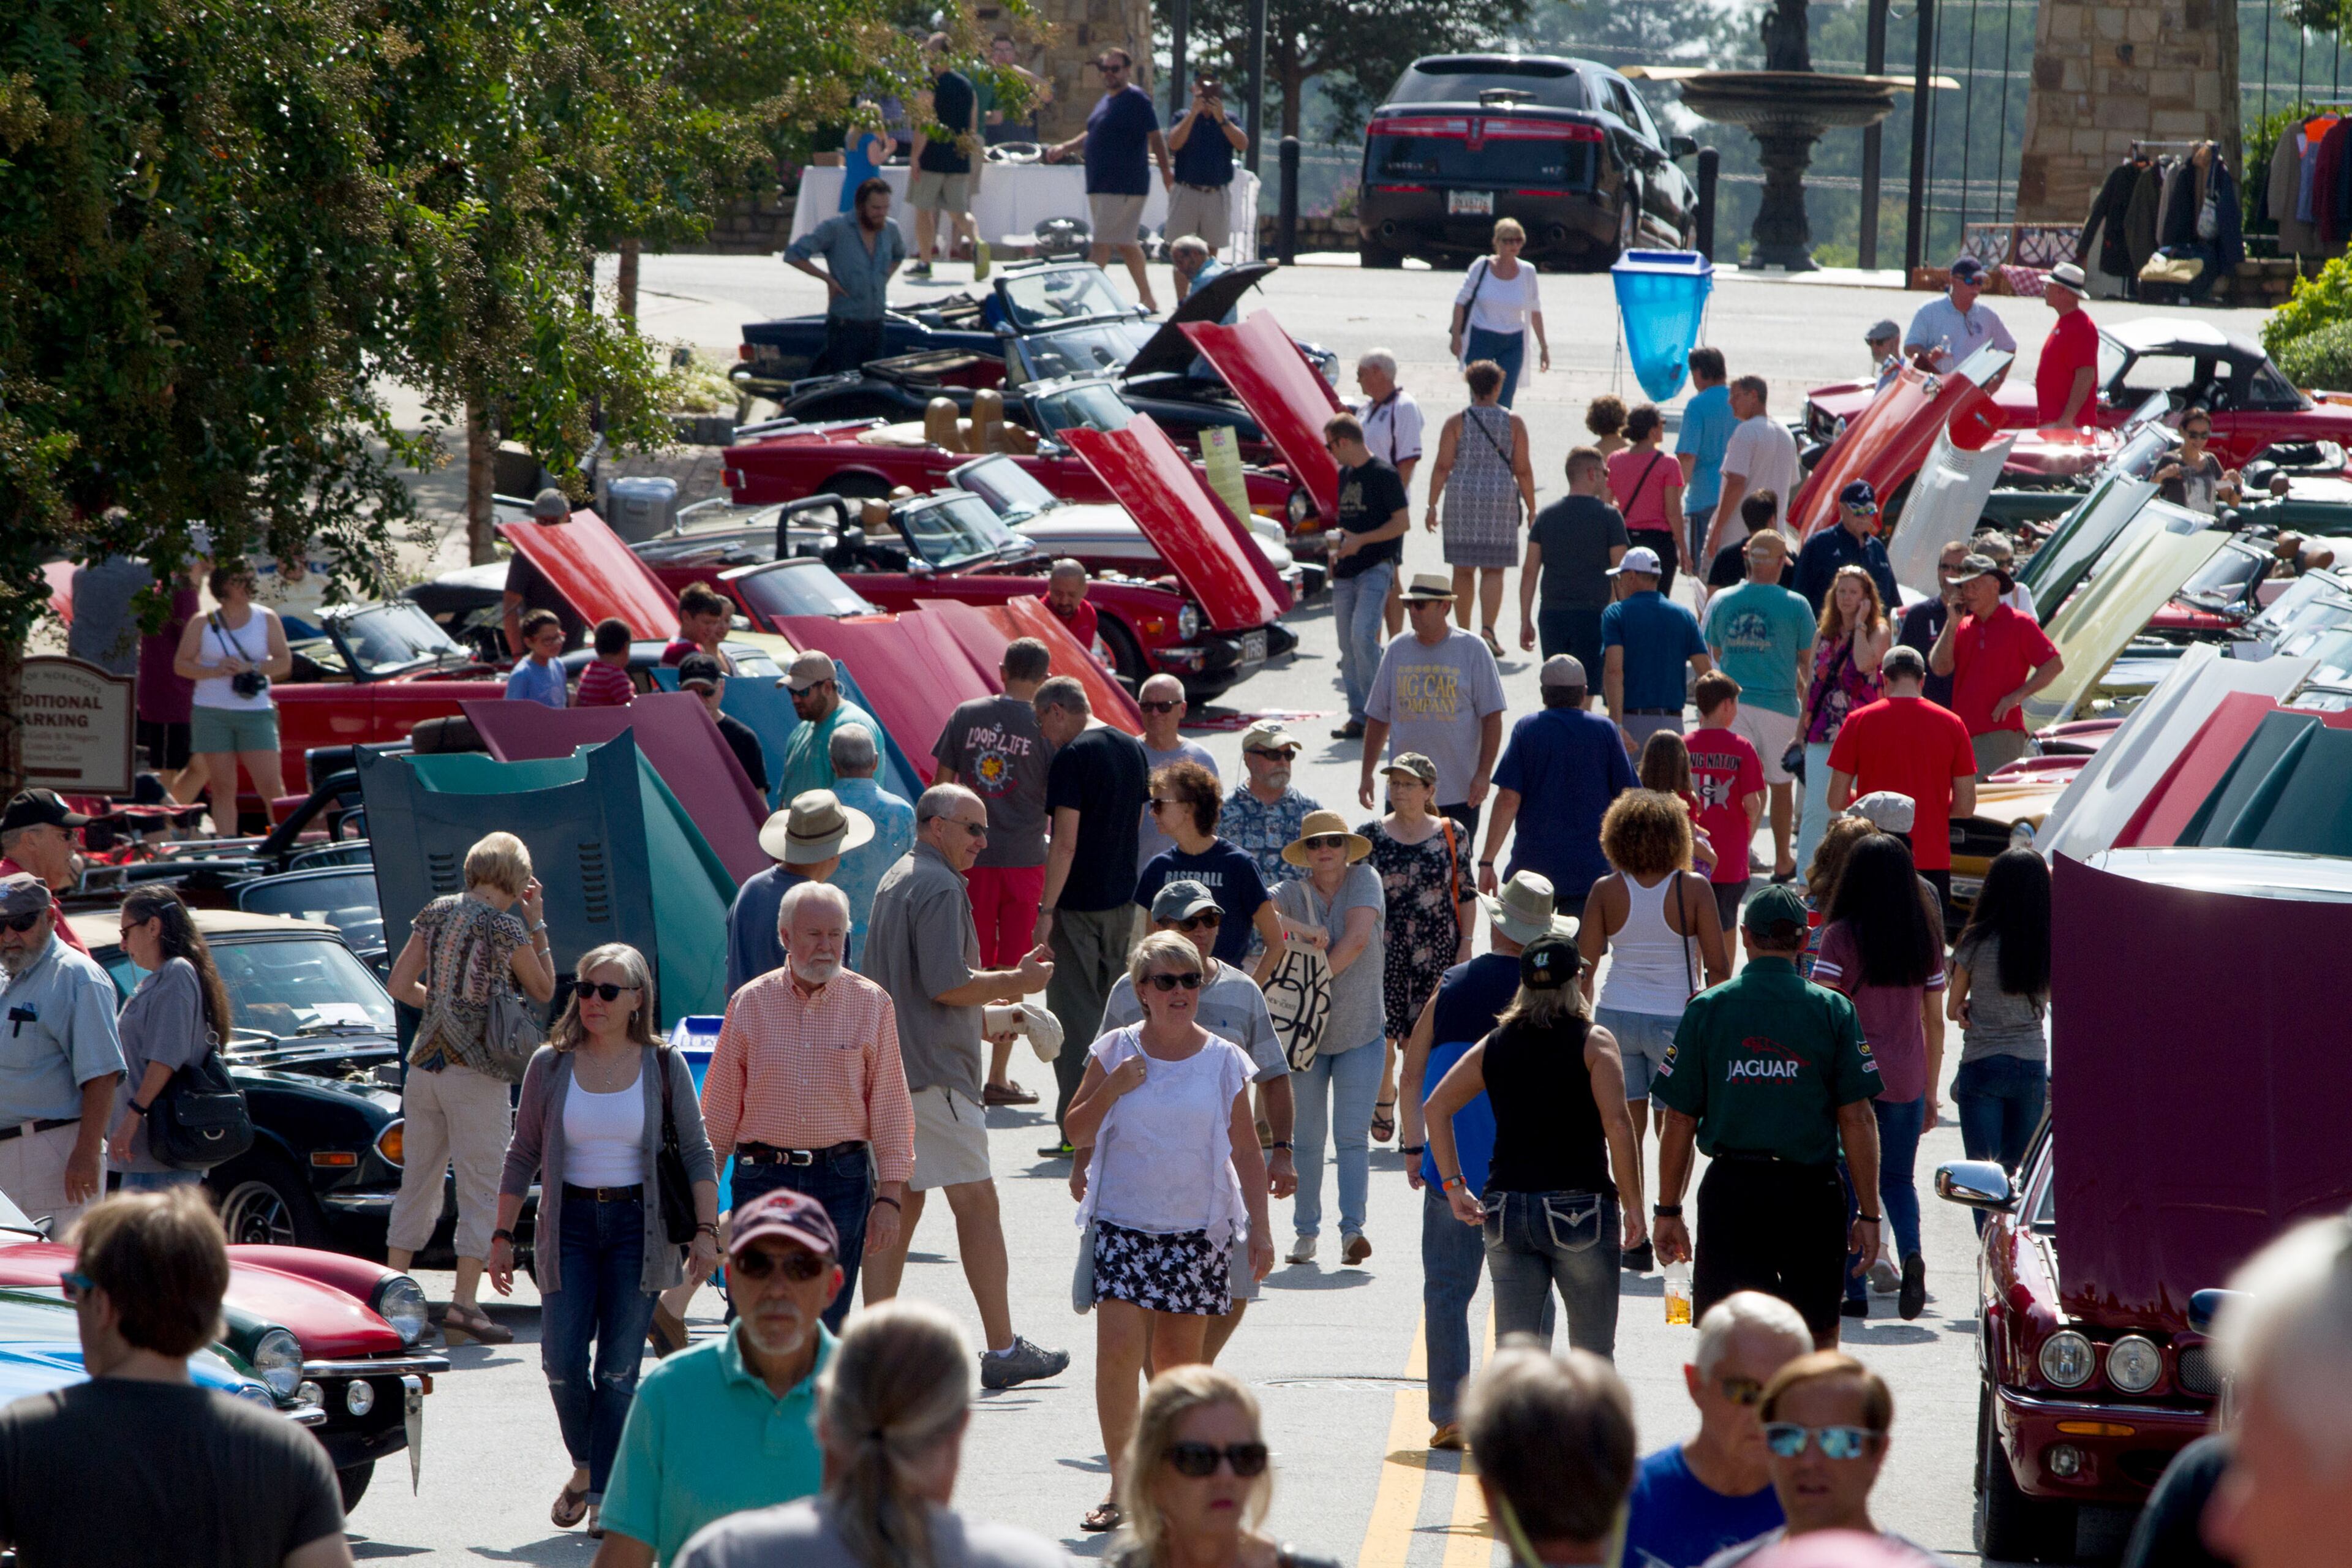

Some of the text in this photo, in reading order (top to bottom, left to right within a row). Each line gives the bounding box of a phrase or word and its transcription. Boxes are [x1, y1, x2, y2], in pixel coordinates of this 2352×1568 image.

[1424, 675, 1457, 698] CAR
[23, 695, 103, 709] DITIONAL
[24, 713, 89, 728] ARKING
[965, 727, 1032, 756] LOOP LIFE
[1164, 870, 1224, 886] BASEBALL
[1725, 1060, 1799, 1082] JAGUAR
